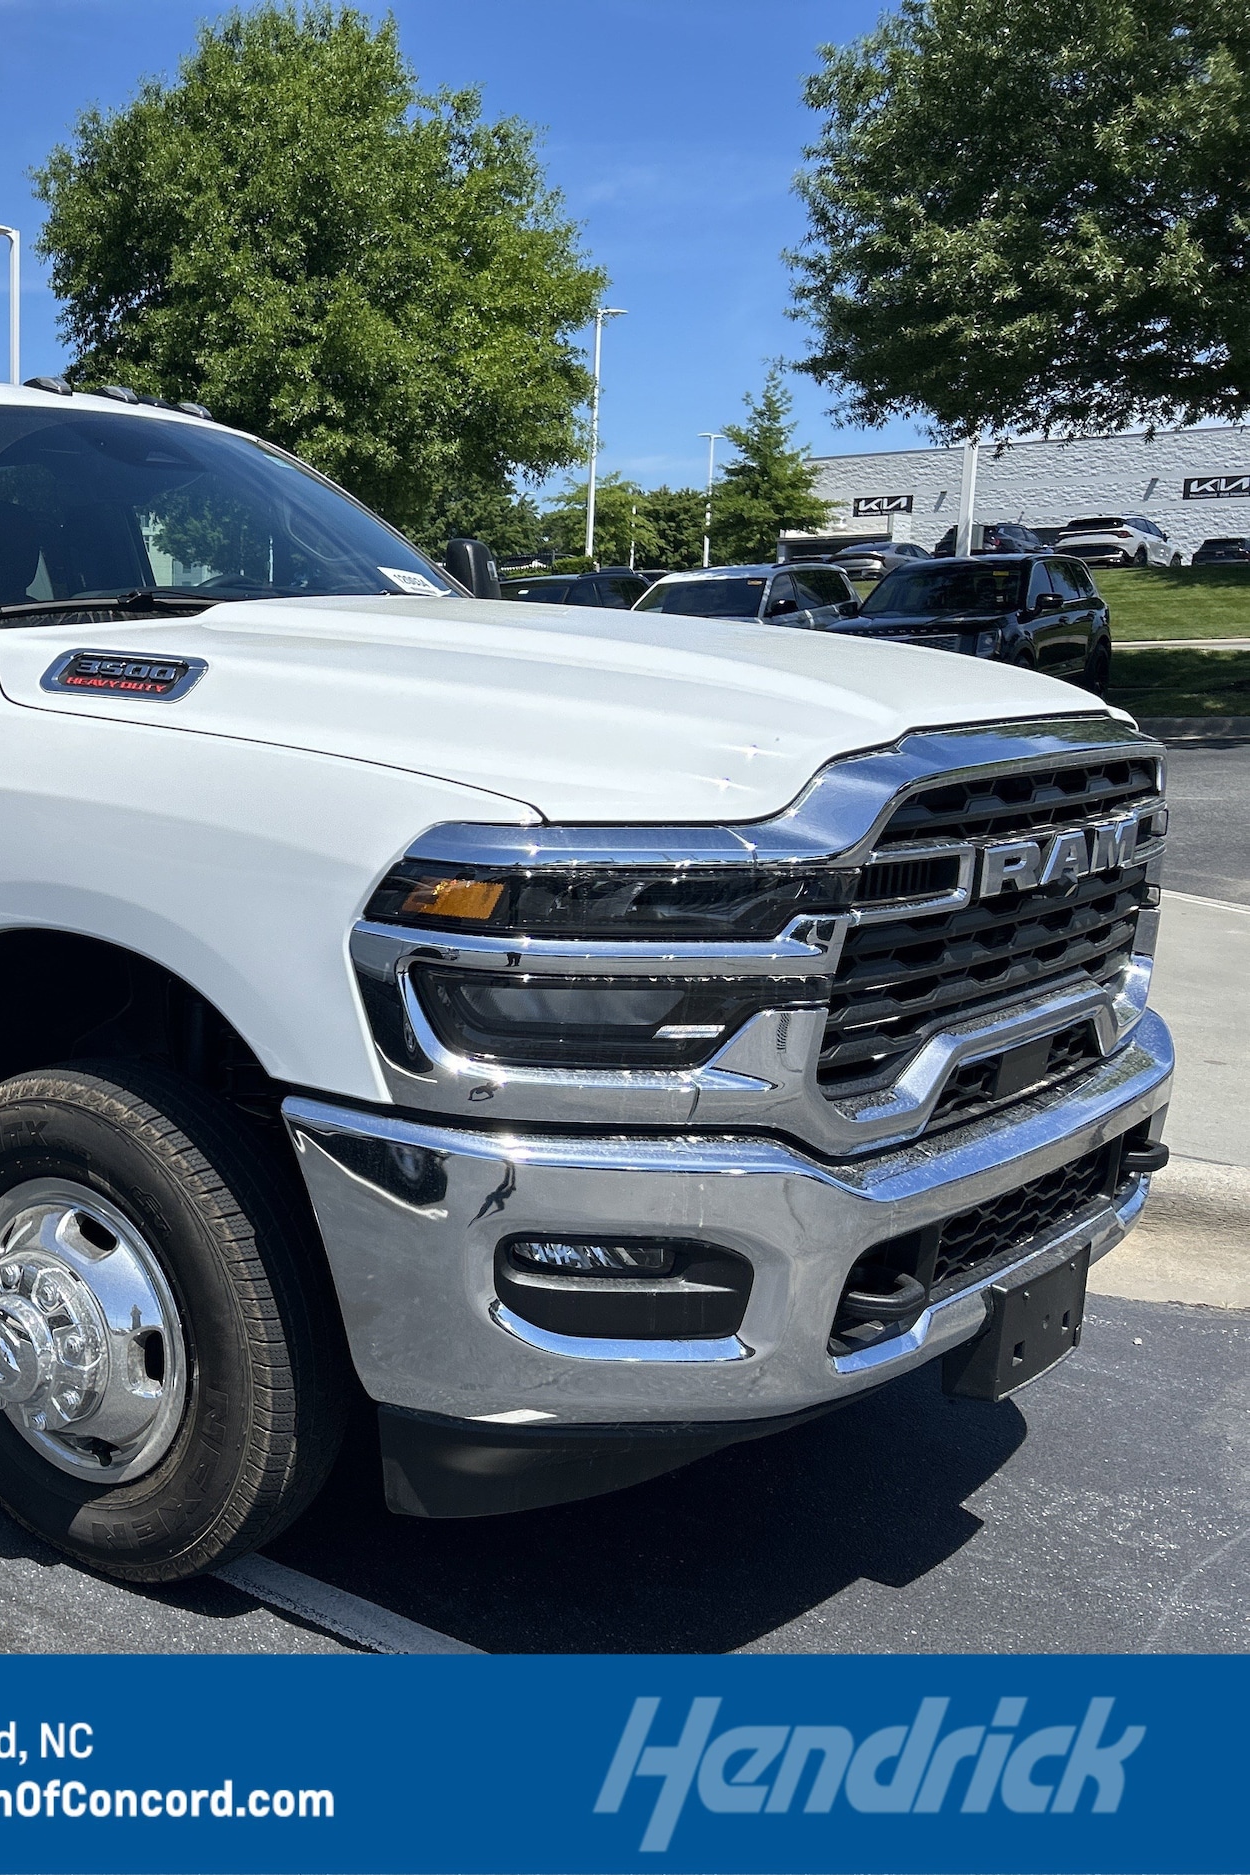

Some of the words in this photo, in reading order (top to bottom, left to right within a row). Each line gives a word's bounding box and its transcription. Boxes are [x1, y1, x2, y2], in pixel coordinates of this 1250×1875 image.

[75, 659, 176, 681] 3500
[66, 677, 117, 689] HEAVY
[119, 681, 167, 693] DUTY
[980, 818, 1138, 898] RAM
